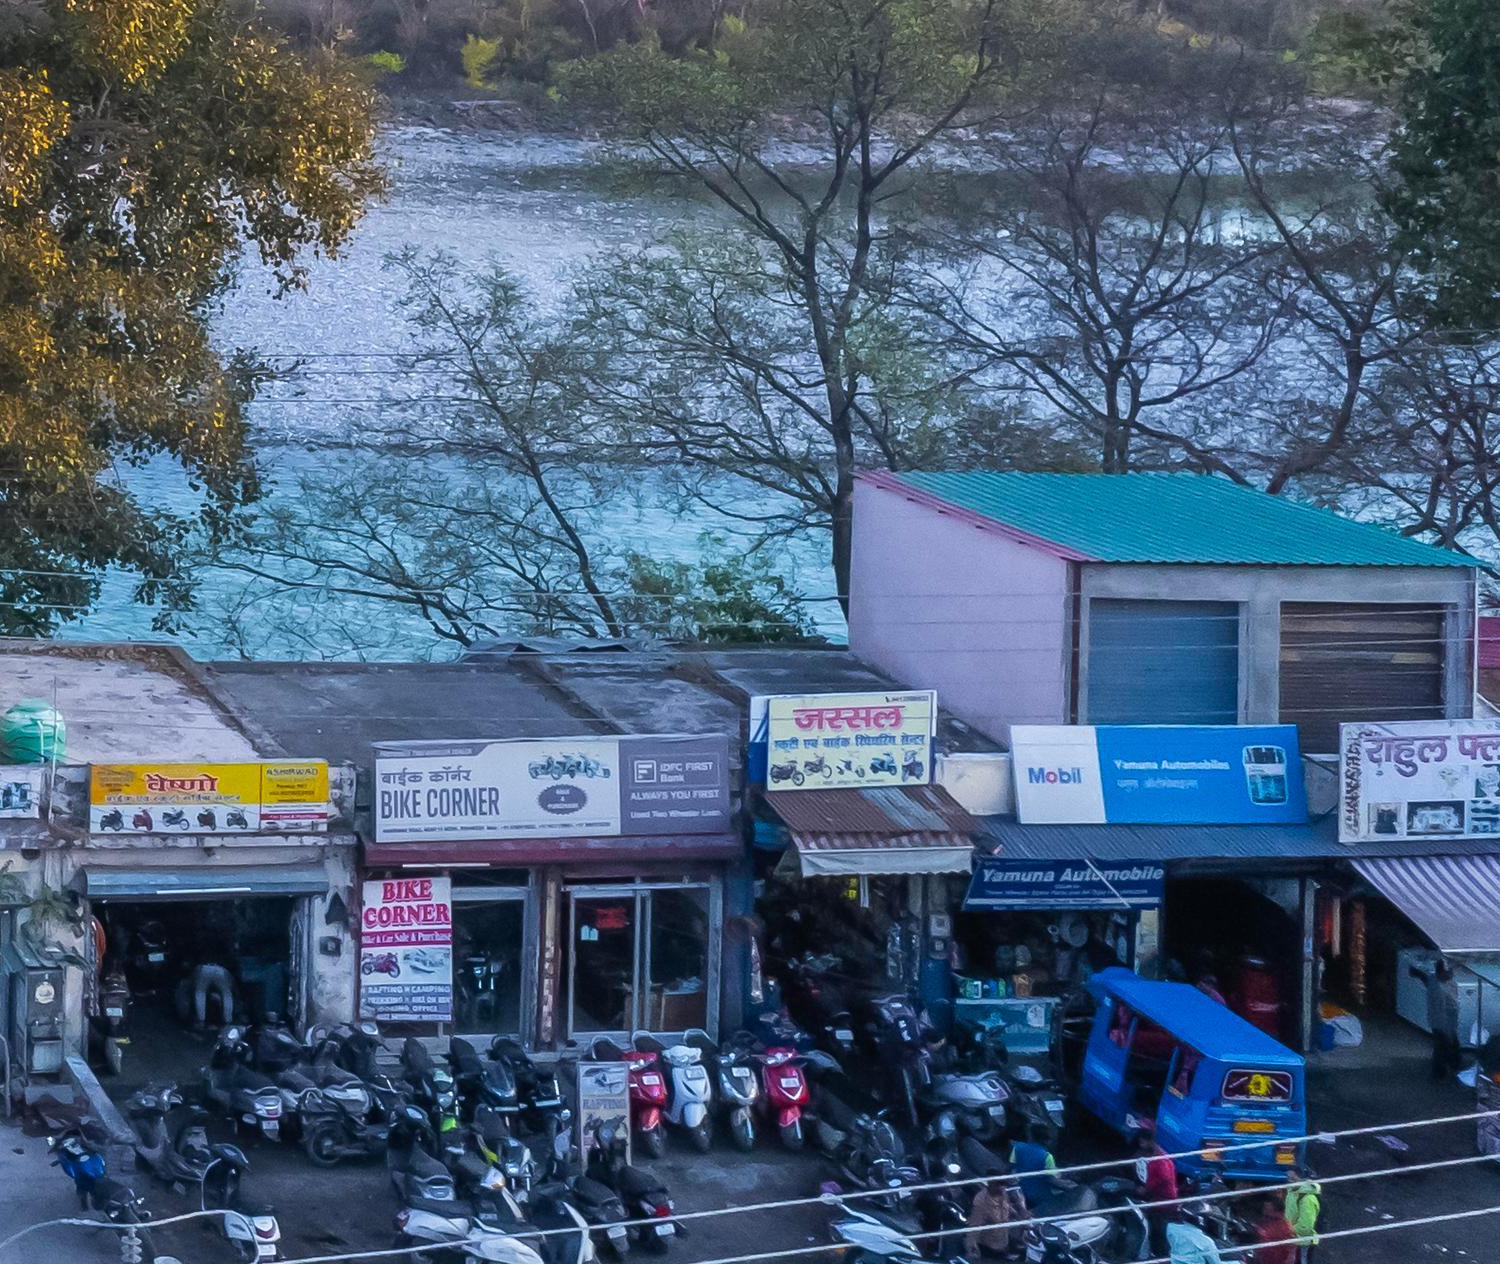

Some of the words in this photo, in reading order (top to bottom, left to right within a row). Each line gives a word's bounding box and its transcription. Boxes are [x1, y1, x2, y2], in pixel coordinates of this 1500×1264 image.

[660, 763, 682, 772] IDFC
[685, 762, 713, 771] FIRST
[1113, 759, 1158, 770] Yamuna
[381, 767, 424, 787] बाईक
[429, 765, 472, 783] कॉर्नर
[660, 774, 684, 783] Bank
[1028, 767, 1082, 784] Mobil
[381, 789, 421, 819] BIKE
[426, 787, 500, 818] CORNER
[630, 791, 668, 801] ALWAYS
[670, 790, 690, 800] YOU
[692, 789, 719, 798] FIRST
[983, 869, 1055, 883] Yamuna
[1060, 866, 1164, 882] Automobile
[382, 879, 433, 903] BIKE
[363, 903, 450, 929] CORNER
